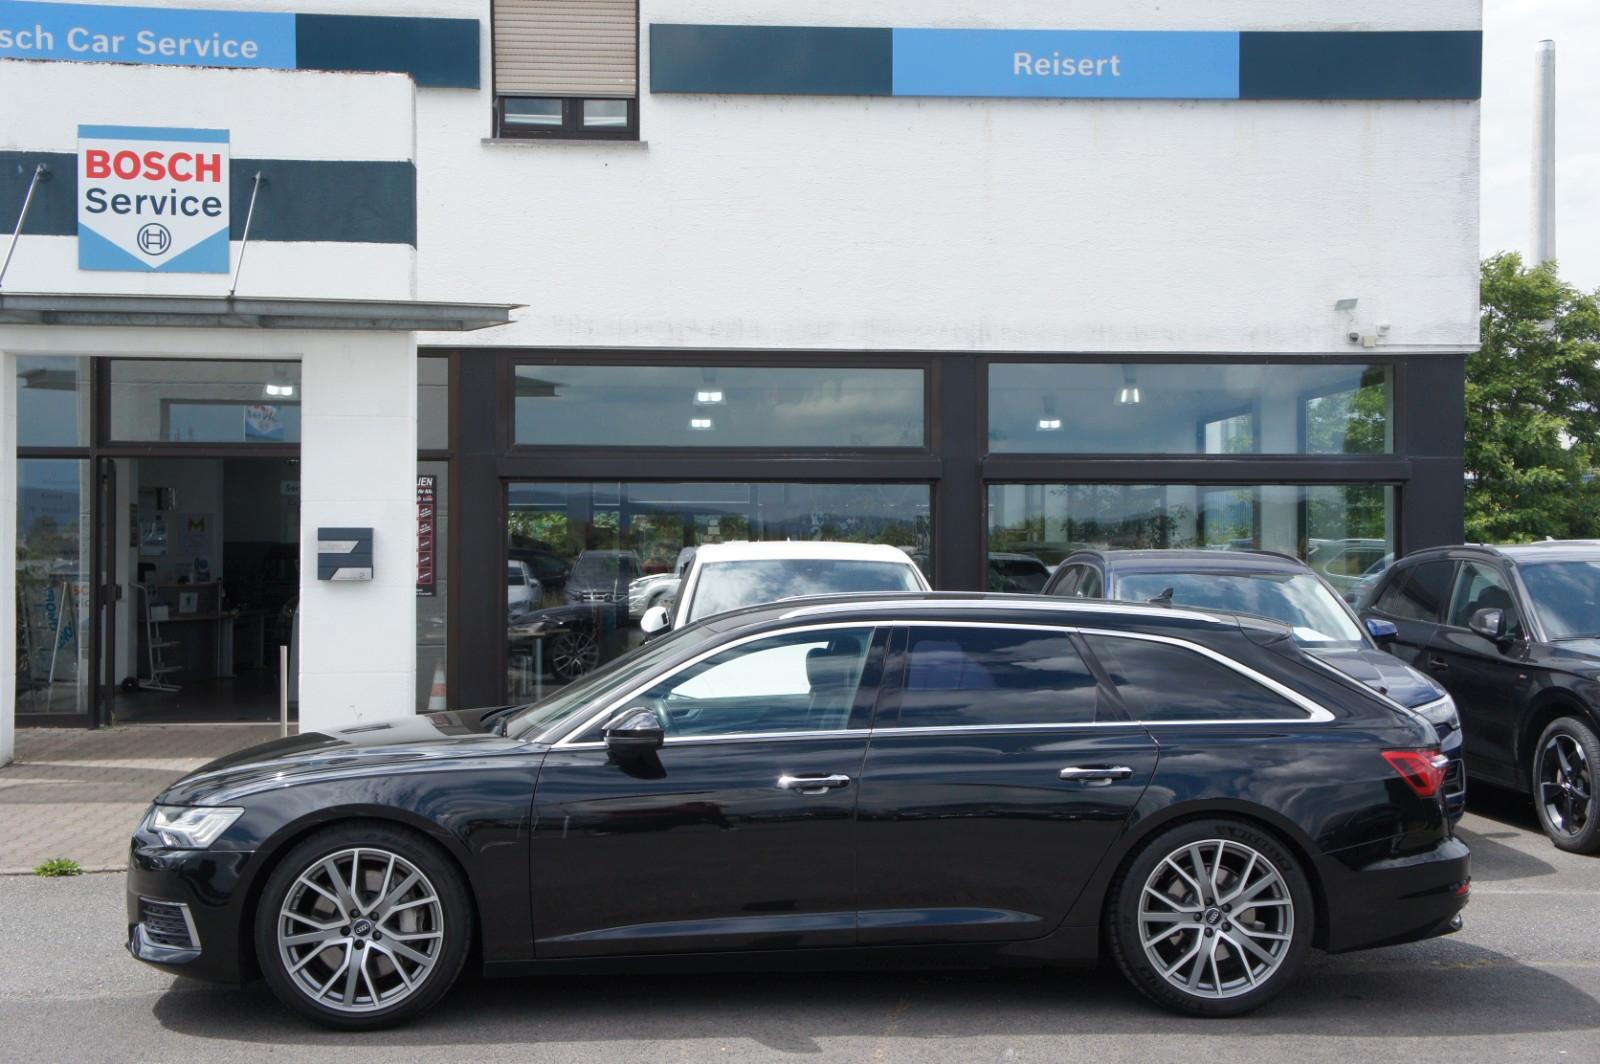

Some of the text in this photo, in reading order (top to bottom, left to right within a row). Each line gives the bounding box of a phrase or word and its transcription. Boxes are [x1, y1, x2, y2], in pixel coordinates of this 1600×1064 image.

[0, 24, 259, 58] sch Car Service
[1013, 51, 1121, 77] Reisert
[85, 149, 221, 183] BOSCH
[85, 188, 222, 218] Service
